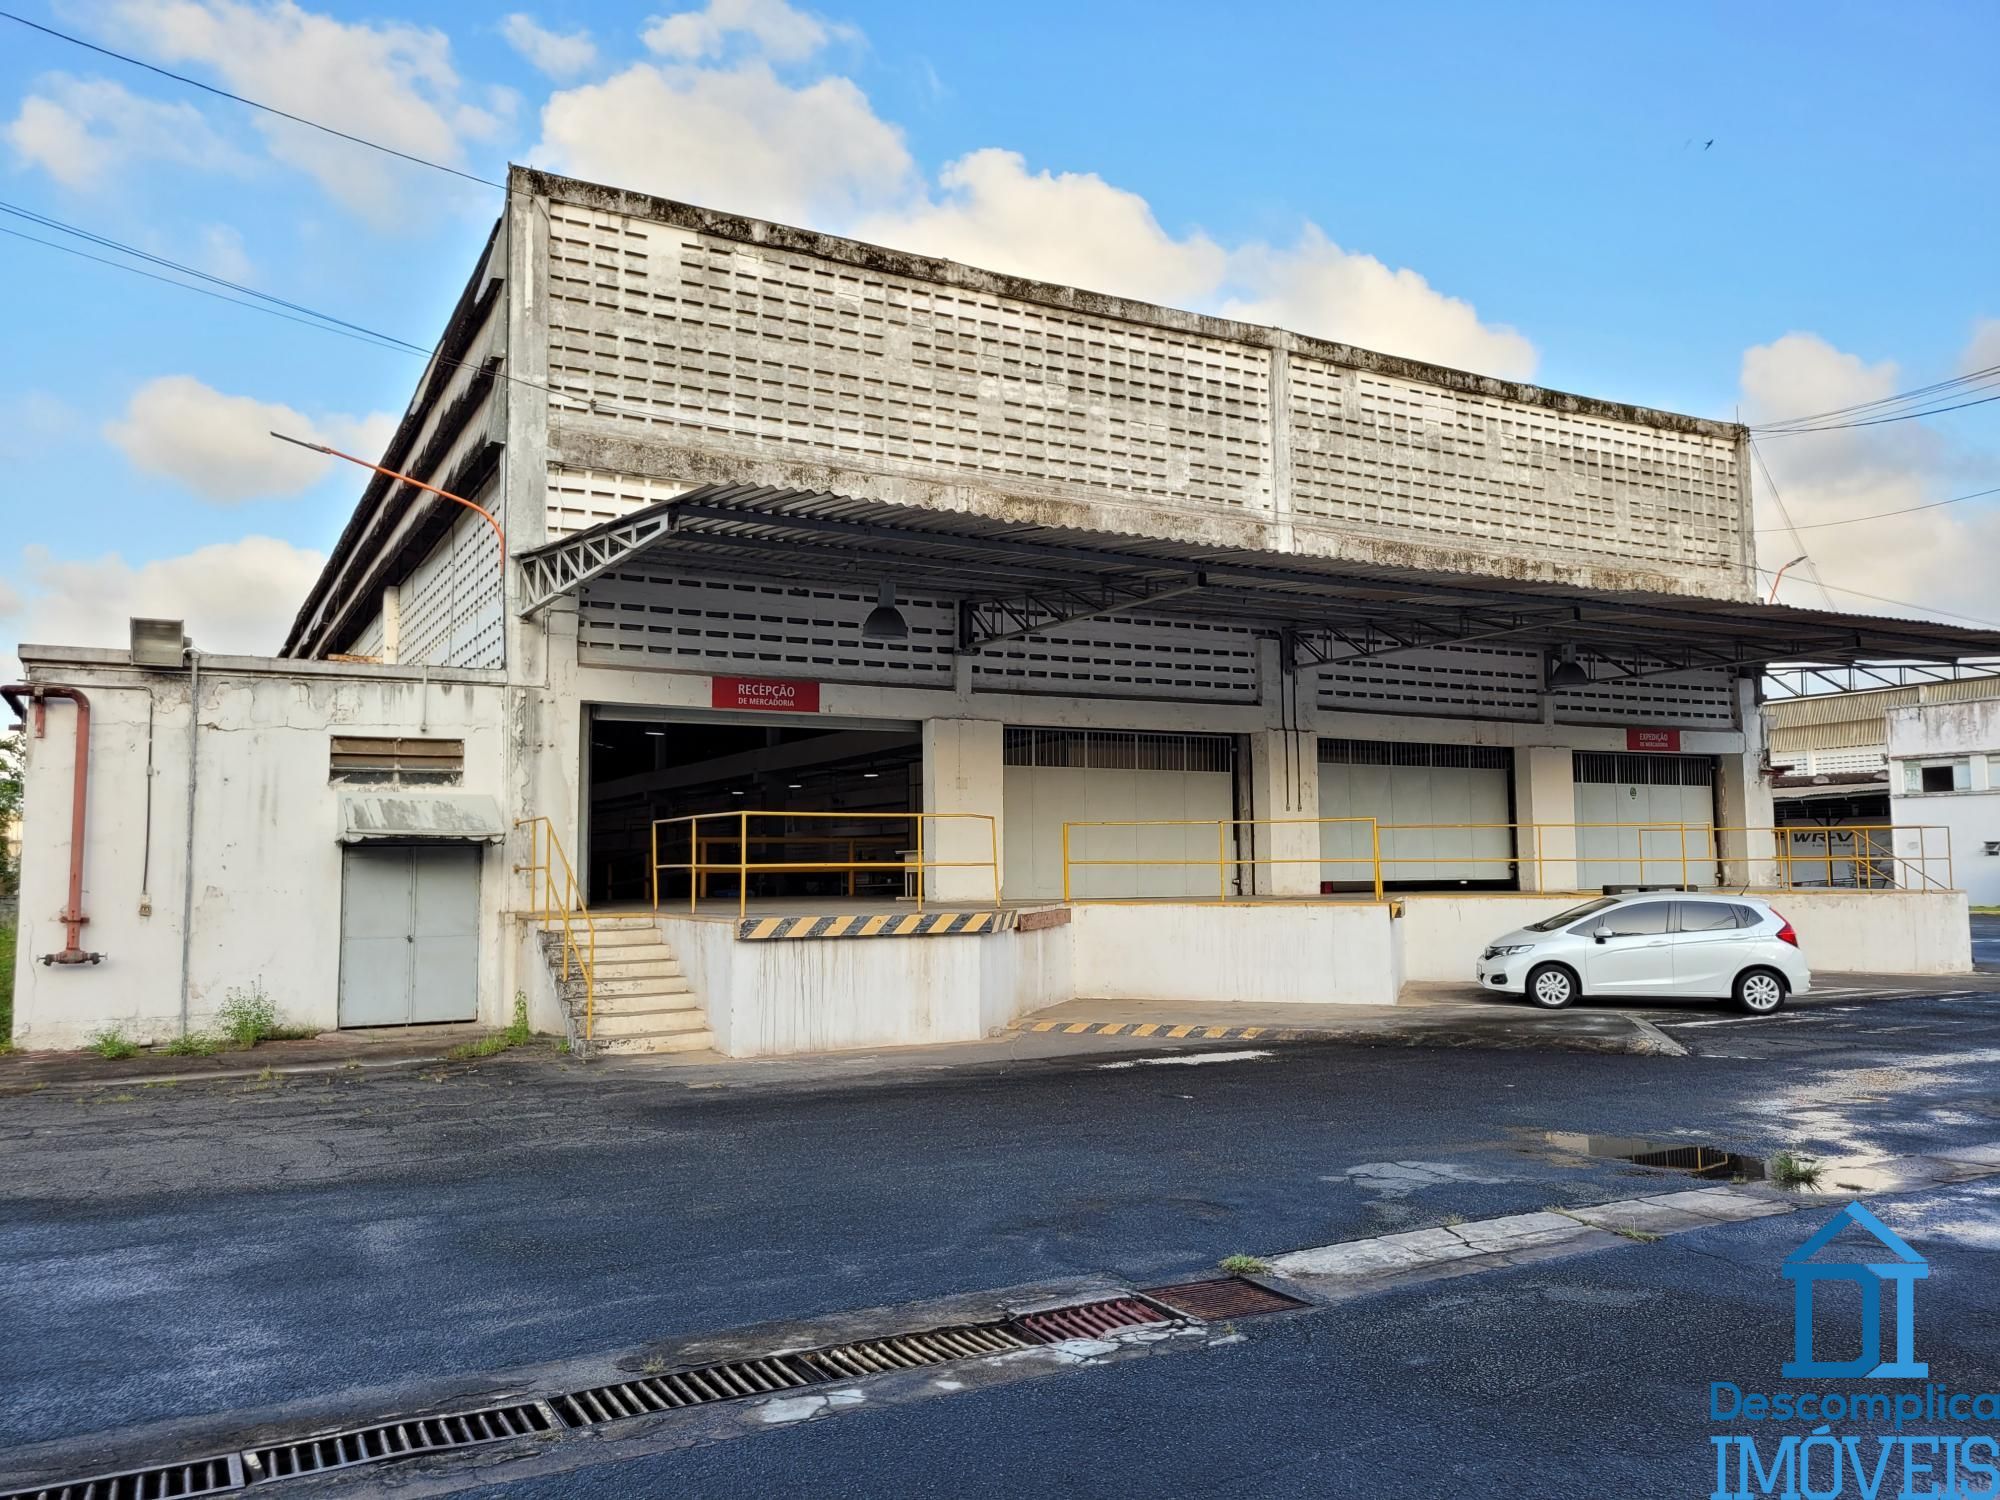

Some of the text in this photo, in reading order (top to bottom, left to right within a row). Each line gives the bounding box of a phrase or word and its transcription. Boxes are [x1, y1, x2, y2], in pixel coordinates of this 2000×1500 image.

[738, 683, 795, 699] RECEPÇÃO
[738, 697, 795, 707] DE MERCADORIA
